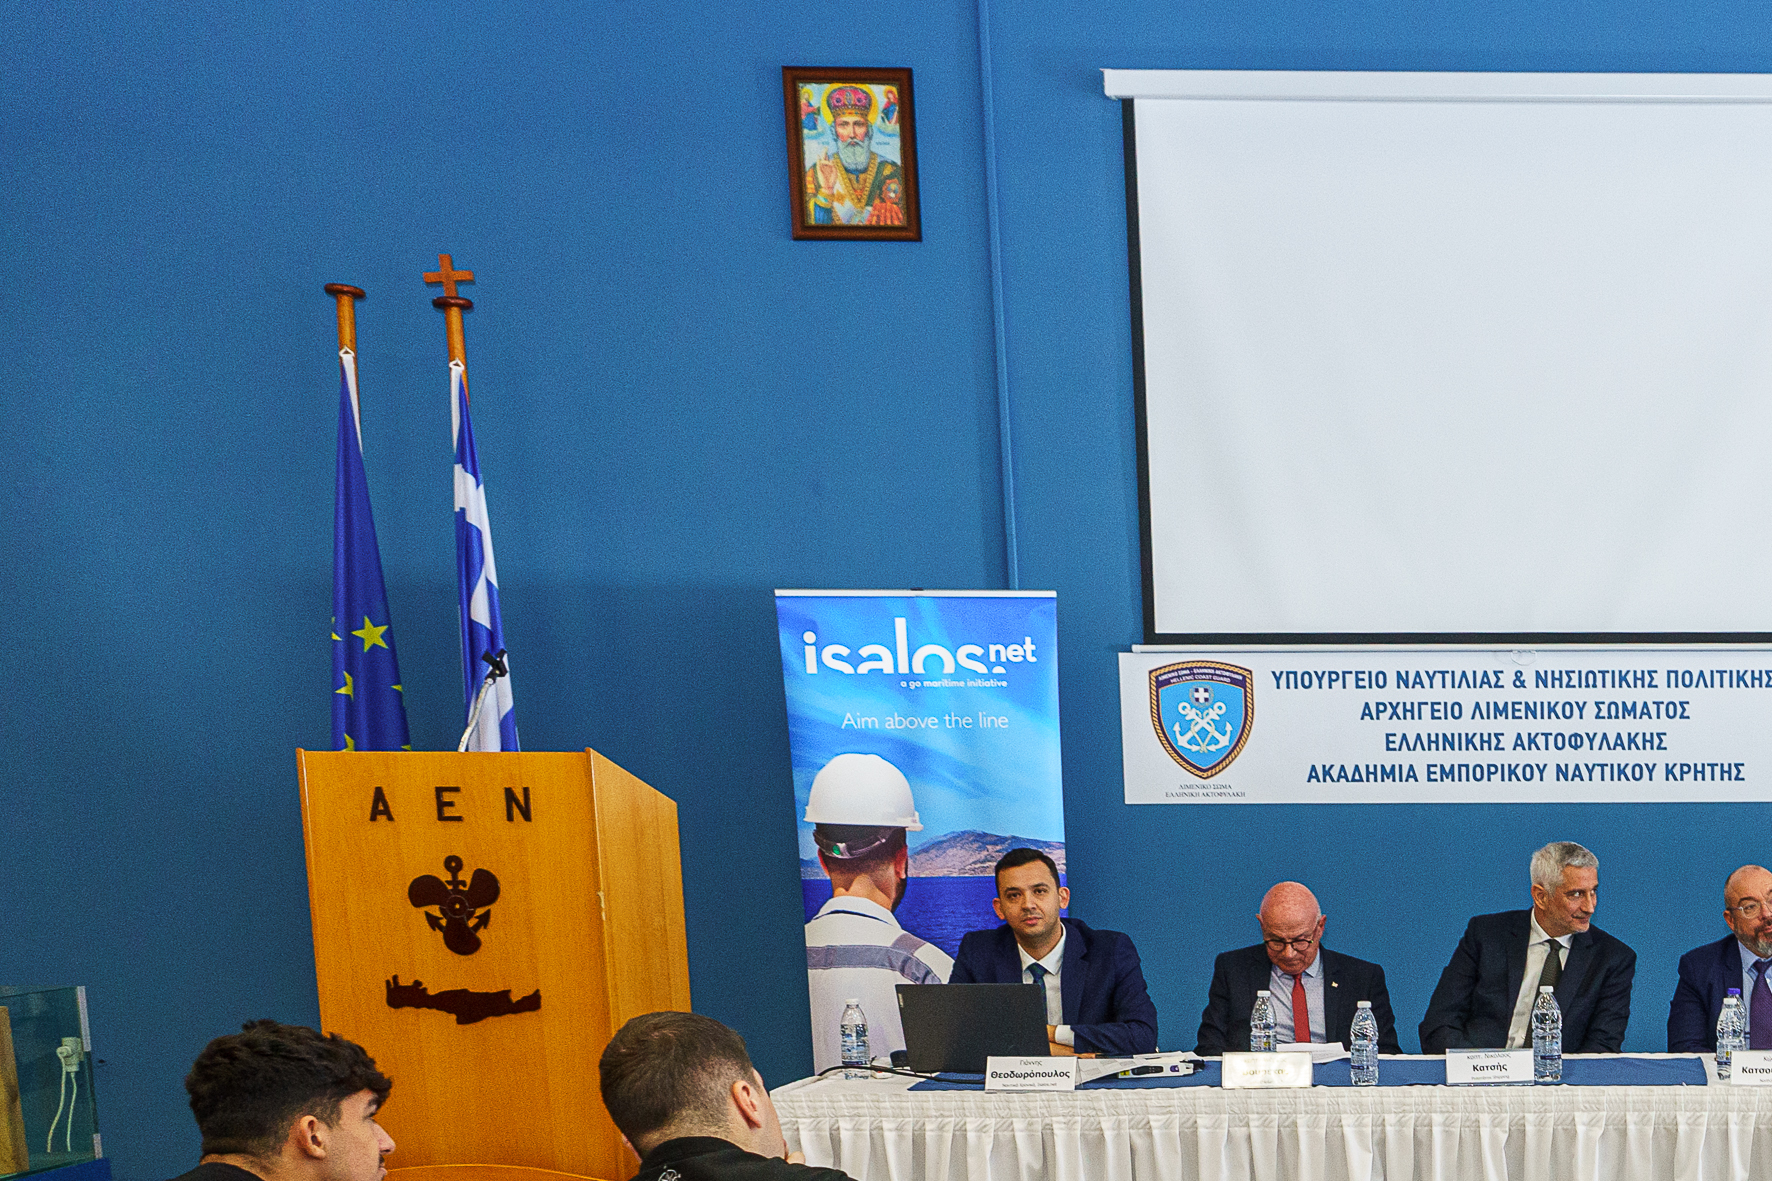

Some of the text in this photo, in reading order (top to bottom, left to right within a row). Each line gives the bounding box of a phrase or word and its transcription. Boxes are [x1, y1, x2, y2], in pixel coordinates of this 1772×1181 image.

[909, 681, 922, 690] go
[924, 678, 965, 688] maritime
[967, 678, 1008, 688] initiative
[1271, 670, 1388, 690] ΥΠΟΥΡΓΕΙΟ
[1396, 670, 1505, 690] ΝΑΥΤΙΛΙΑΣ
[1512, 670, 1527, 689] &
[1535, 669, 1659, 689] ΝΗΣΙΩΤΙΚΗΣ
[1360, 700, 1691, 721] ΑΡΧΗΓΕΙΟ ΛΙΜΕΝΙΚΟΥ ΣΩΜΑΤΟΣ
[841, 712, 1009, 729] Aim above the line
[1385, 732, 1668, 752] ΕΛΛΗΝΙΚΗΣ ΑΚΤΟΦΥΛΑΚΗΣ
[1306, 762, 1746, 783] ΑΚΑΔΗΜΙΑ ΕΜΠΟΡΙΚΟΥ ΝΑΥΤΙΚΟΥ ΚΡΗΤΗΣ
[990, 1069, 1071, 1080] Θεοδωρόπουλος
[1472, 1062, 1508, 1072] Κατσής
